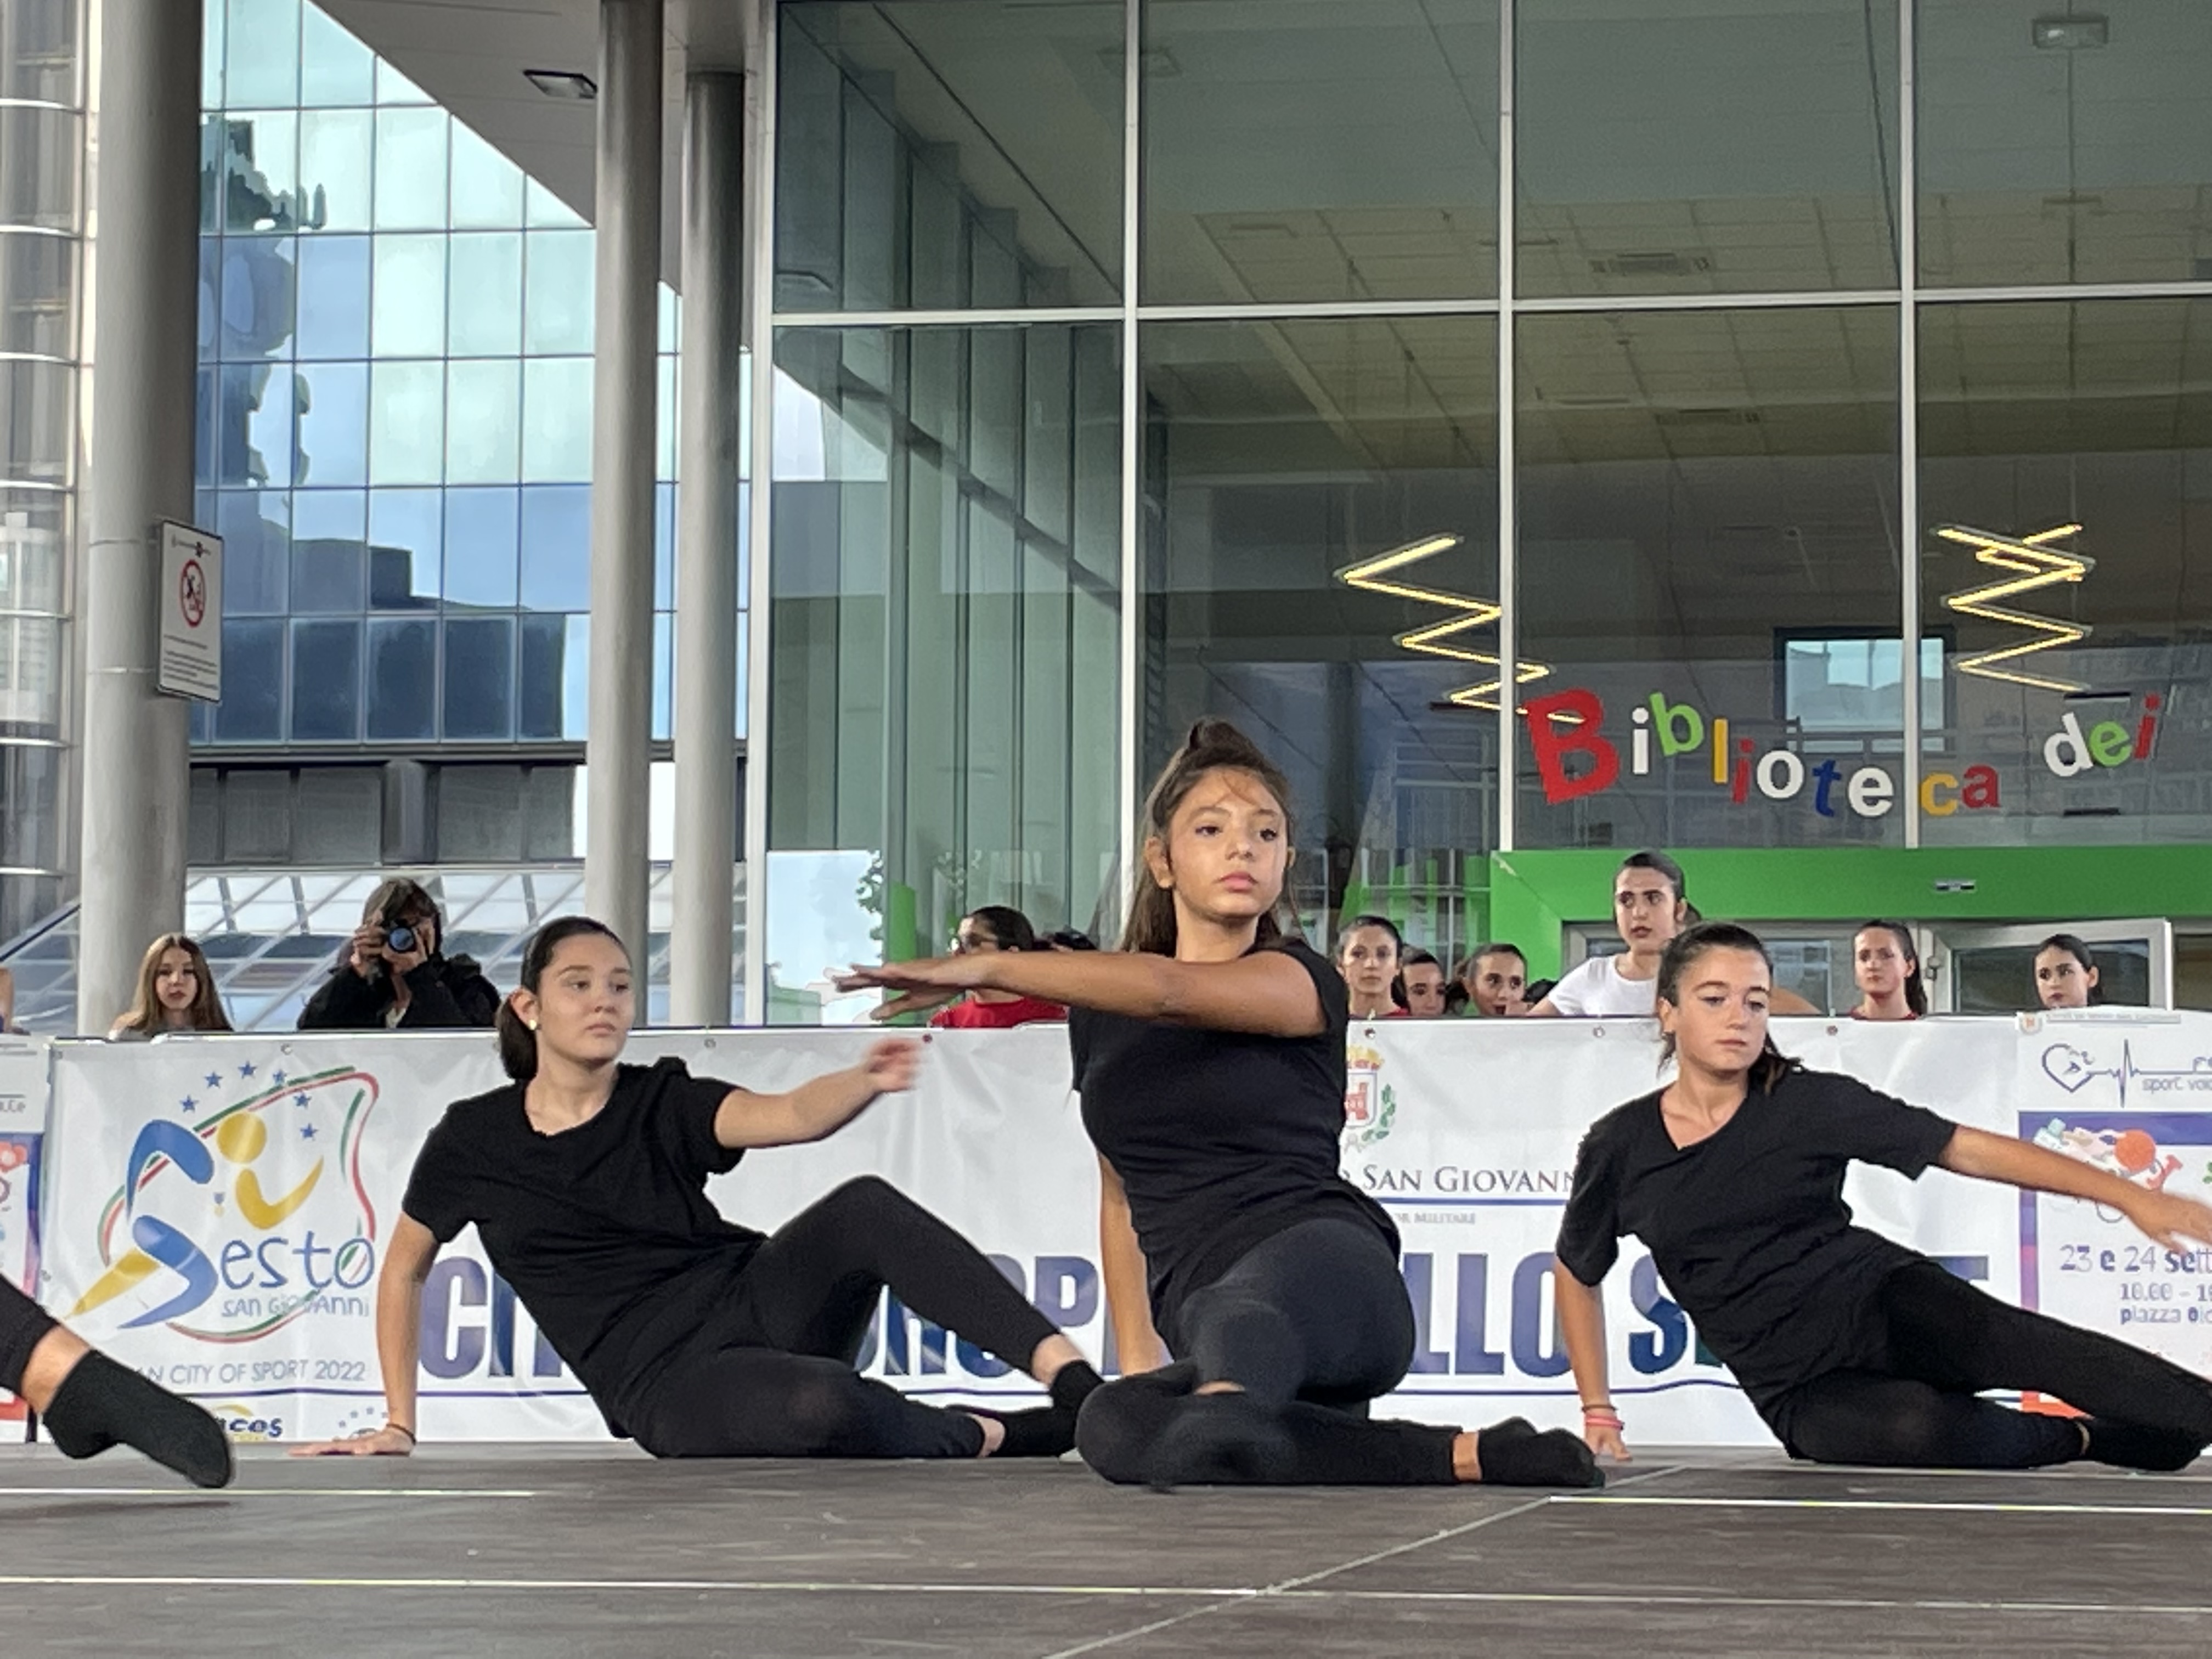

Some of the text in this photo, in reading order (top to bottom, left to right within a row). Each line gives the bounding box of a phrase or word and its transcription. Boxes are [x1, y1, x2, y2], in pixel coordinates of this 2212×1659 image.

[1523, 687, 2160, 817] Biblioteca dei
[1363, 1164, 1574, 1193] SAN GIOVANN
[2059, 1243, 2093, 1273] 23
[2100, 1249, 2115, 1272] e
[2124, 1245, 2156, 1273] 24
[2120, 1282, 2172, 1301] 10.00
[2120, 1306, 2181, 1325] piazza
[170, 1364, 215, 1385] CITY
[219, 1363, 247, 1384] OF
[251, 1359, 309, 1383] SPORT
[314, 1359, 366, 1381] 2022
